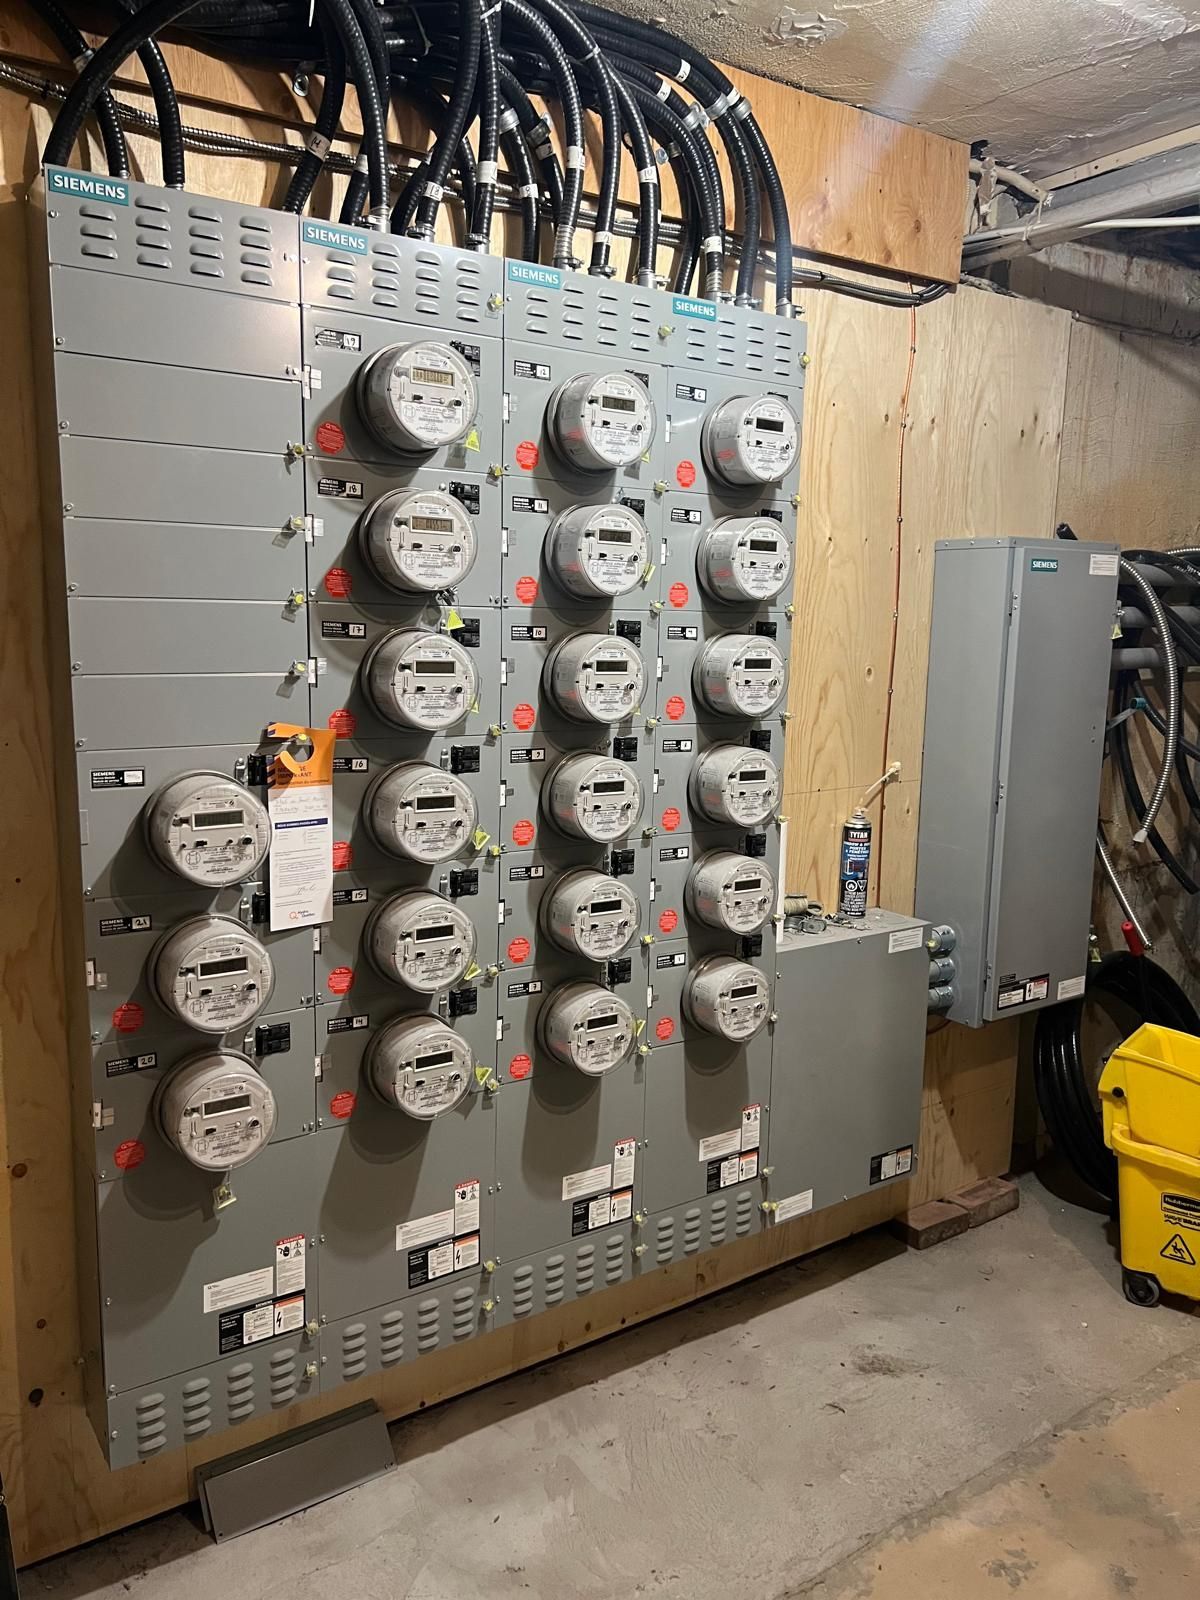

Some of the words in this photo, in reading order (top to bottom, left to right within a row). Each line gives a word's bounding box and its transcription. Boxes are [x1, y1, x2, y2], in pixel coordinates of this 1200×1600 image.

[54, 174, 126, 200] SIEMENS
[307, 226, 366, 250] SIEMENS
[512, 266, 559, 285] SIEMENS
[676, 301, 715, 317] SIEMENS
[346, 336, 356, 346] 19
[349, 484, 357, 493] 18
[1033, 560, 1058, 569] SIEMENS
[352, 625, 362, 633] 17
[355, 760, 363, 768] 16
[850, 831, 868, 839] TYTAN
[355, 891, 363, 899] 15
[135, 919, 147, 927] 21
[355, 1017, 363, 1025] 14
[141, 1056, 153, 1065] 20
